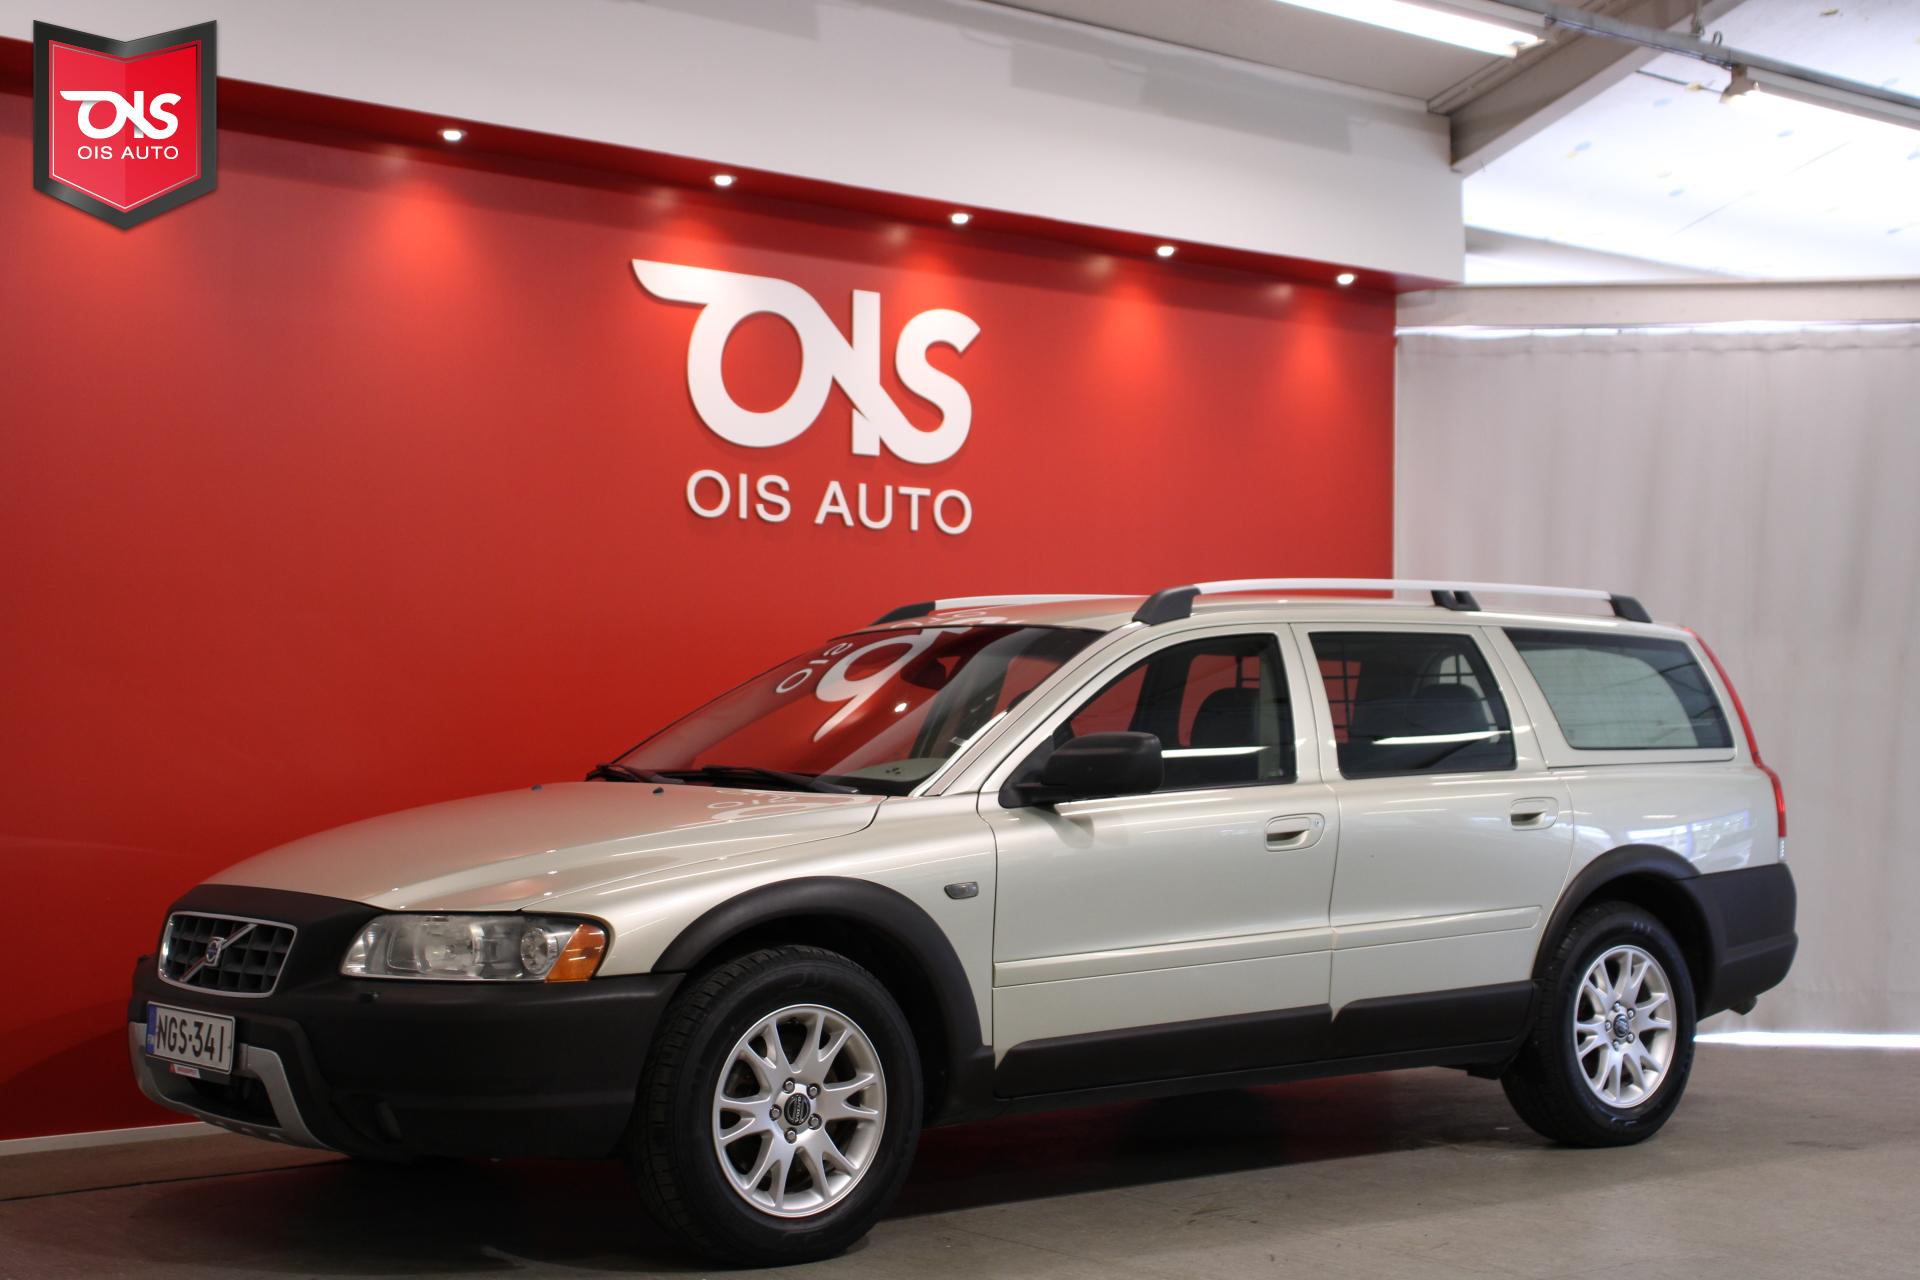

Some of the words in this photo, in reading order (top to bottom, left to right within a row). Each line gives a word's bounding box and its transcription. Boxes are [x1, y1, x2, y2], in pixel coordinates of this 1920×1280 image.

[686, 469, 791, 522] OIS
[814, 480, 972, 535] AUTO
[156, 1014, 225, 1063] NGS-341
